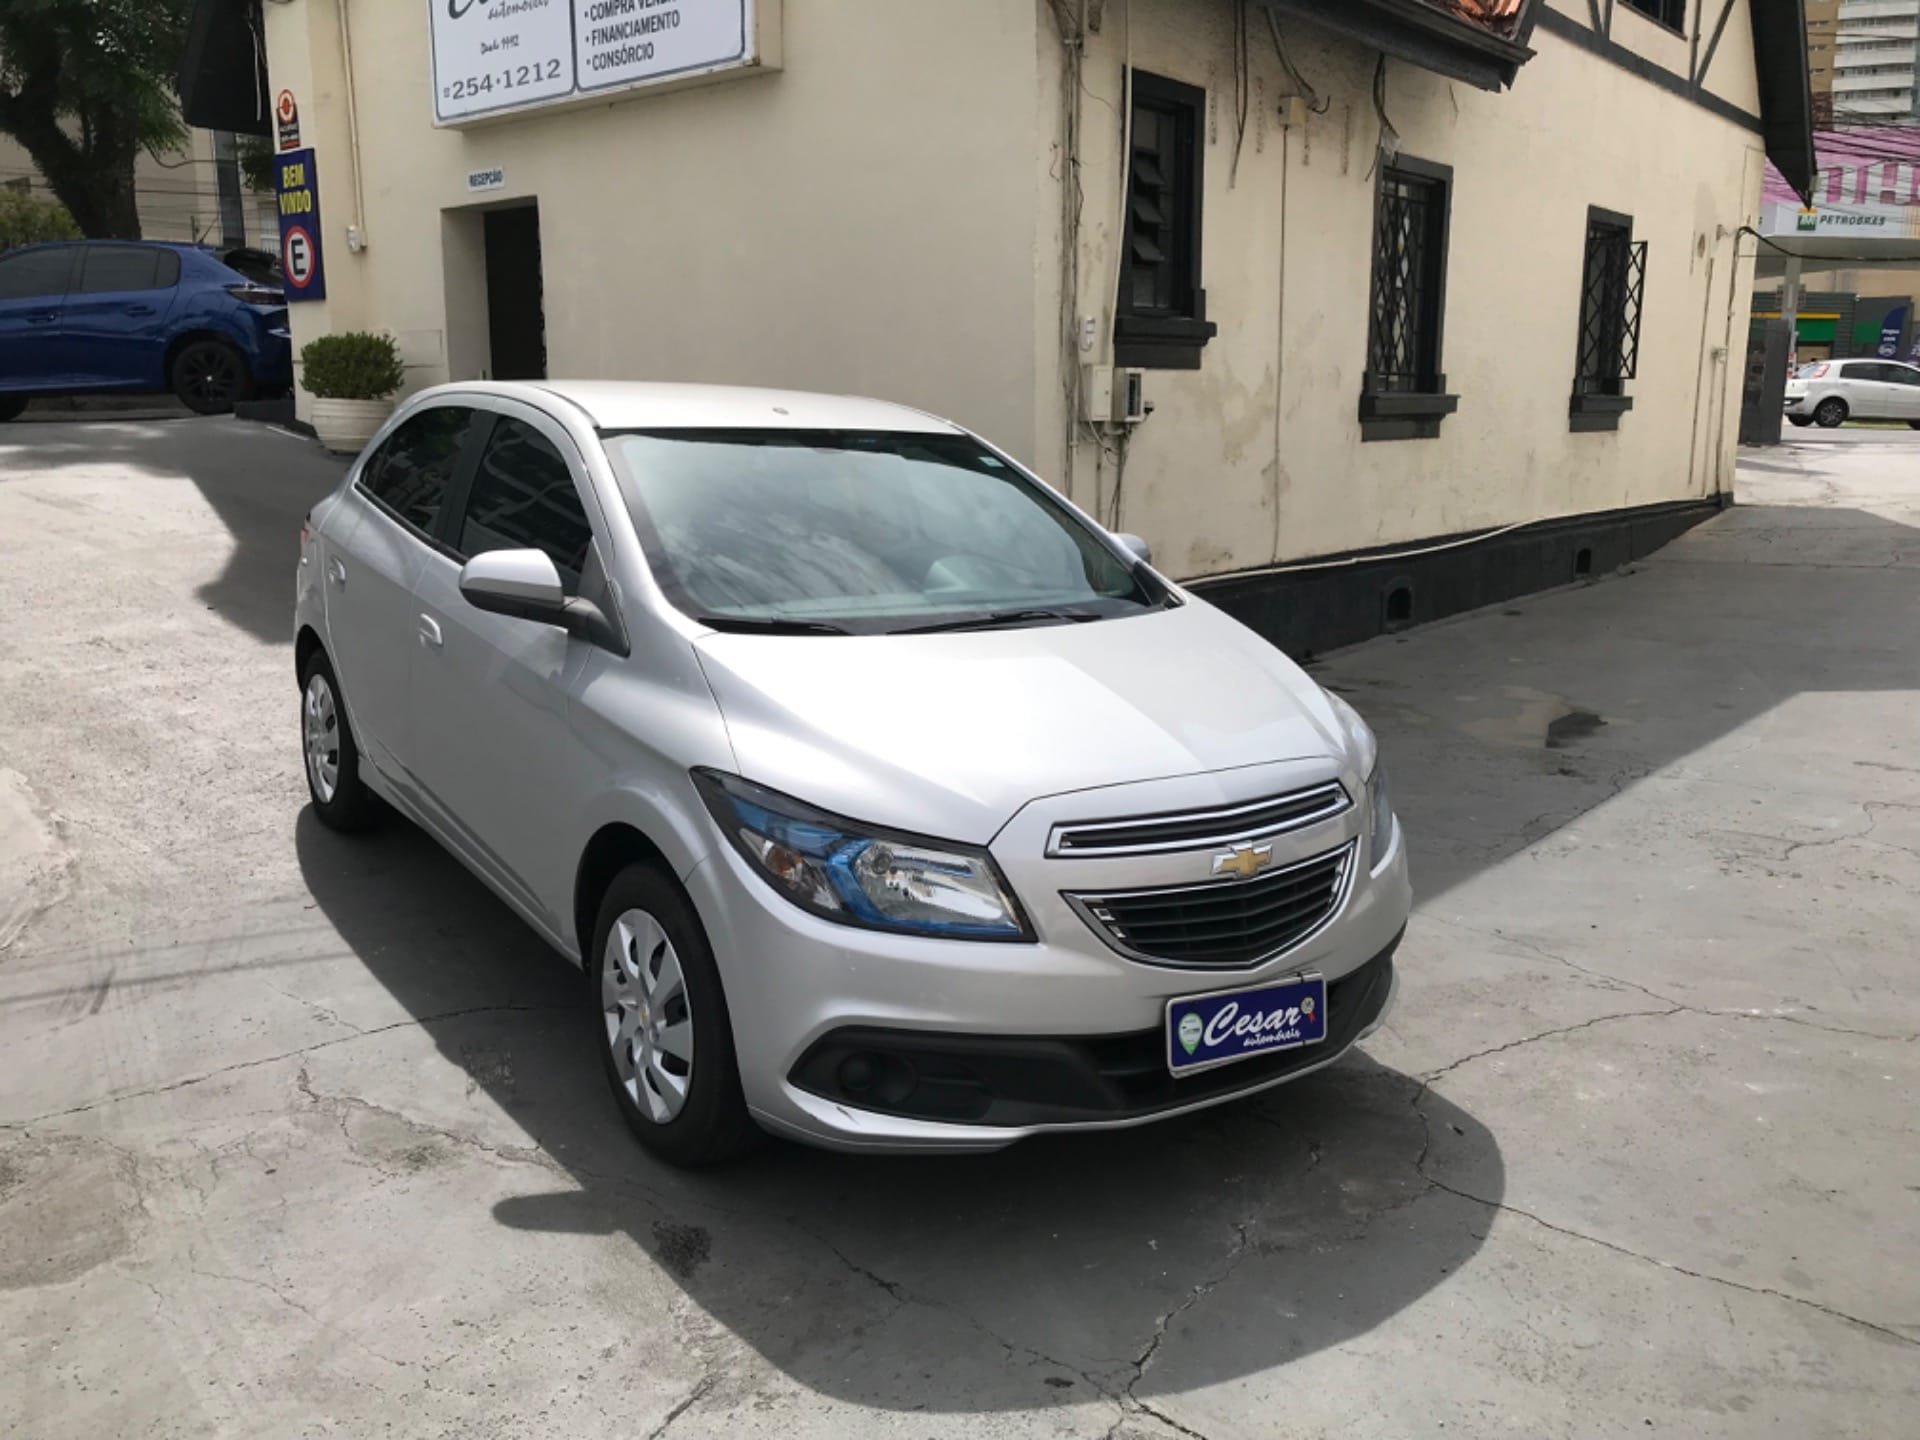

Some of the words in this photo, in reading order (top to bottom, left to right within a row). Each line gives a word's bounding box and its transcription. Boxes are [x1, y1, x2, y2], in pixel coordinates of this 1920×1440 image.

[590, 0, 635, 20] COMPRA
[591, 9, 680, 46] FINANCIAMENTO
[592, 42, 654, 71] CONSÓRCIO
[282, 164, 305, 188] BEM
[279, 190, 312, 216] VINDO
[1819, 214, 1886, 226] PETROBRAS
[291, 239, 306, 275] E
[1203, 1002, 1301, 1047] Cesar
